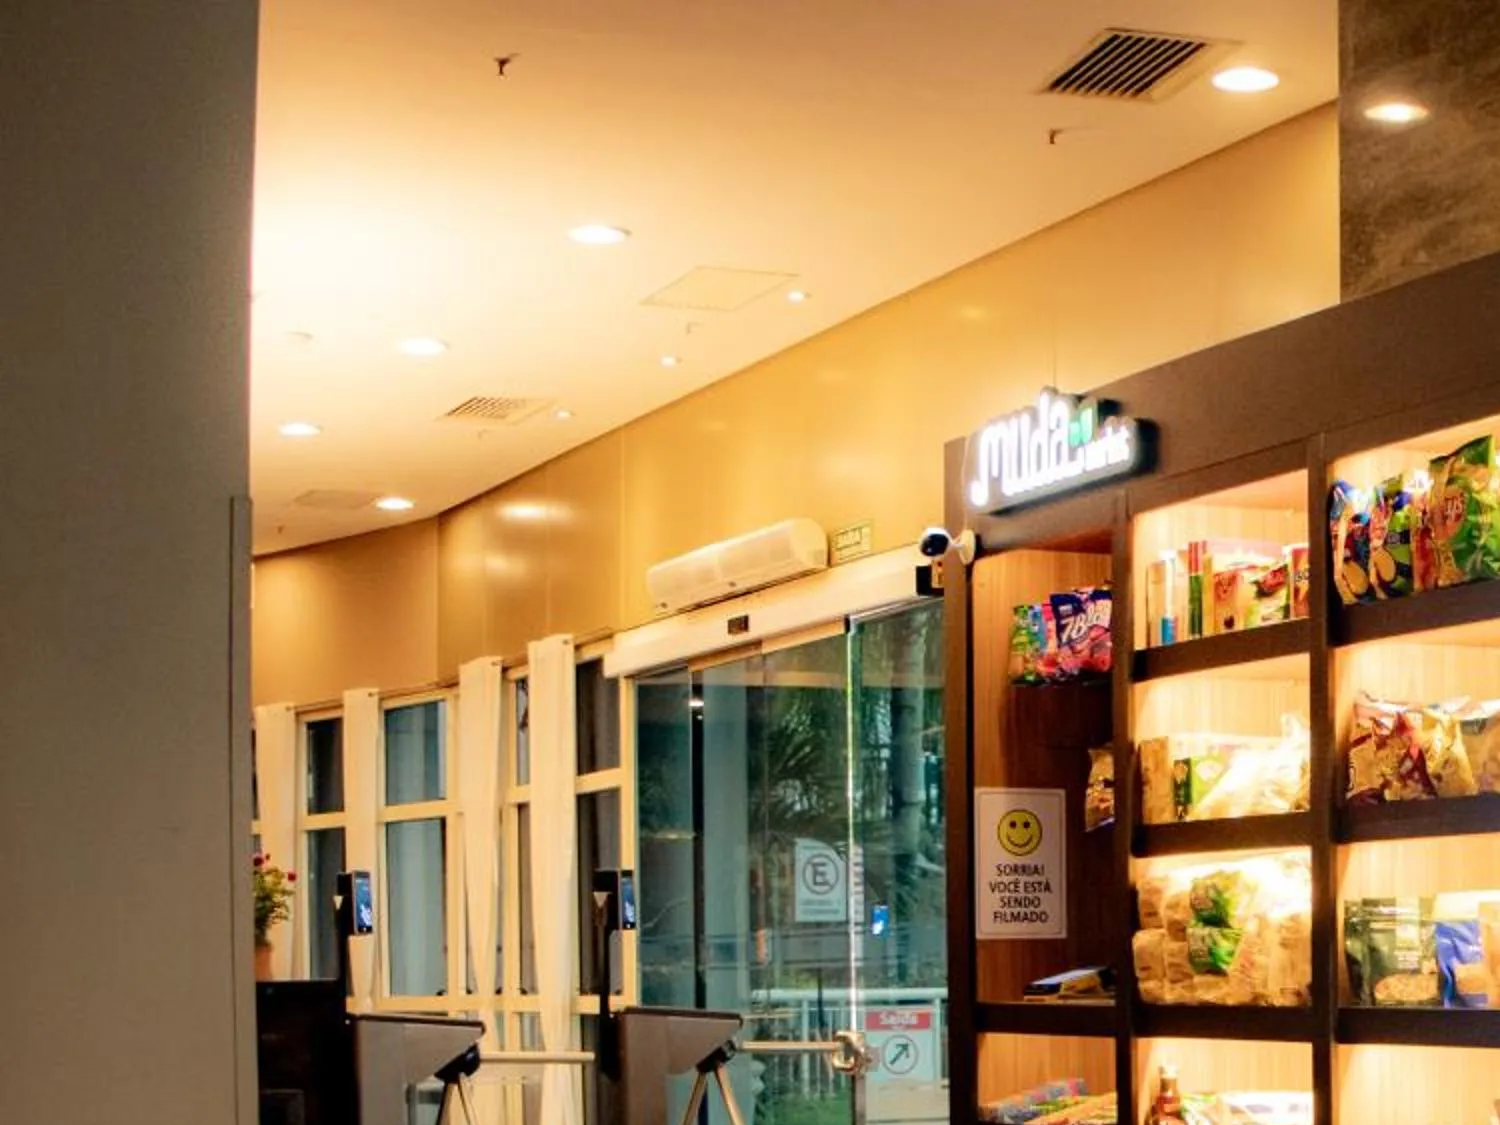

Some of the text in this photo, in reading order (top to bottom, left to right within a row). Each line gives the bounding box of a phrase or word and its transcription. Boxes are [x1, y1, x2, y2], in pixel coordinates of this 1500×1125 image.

[995, 863, 1046, 878] SORRIA!
[989, 877, 1053, 894] VOCÊ ESTÁ
[999, 895, 1042, 910] SENDO
[993, 910, 1050, 924] FILMADO
